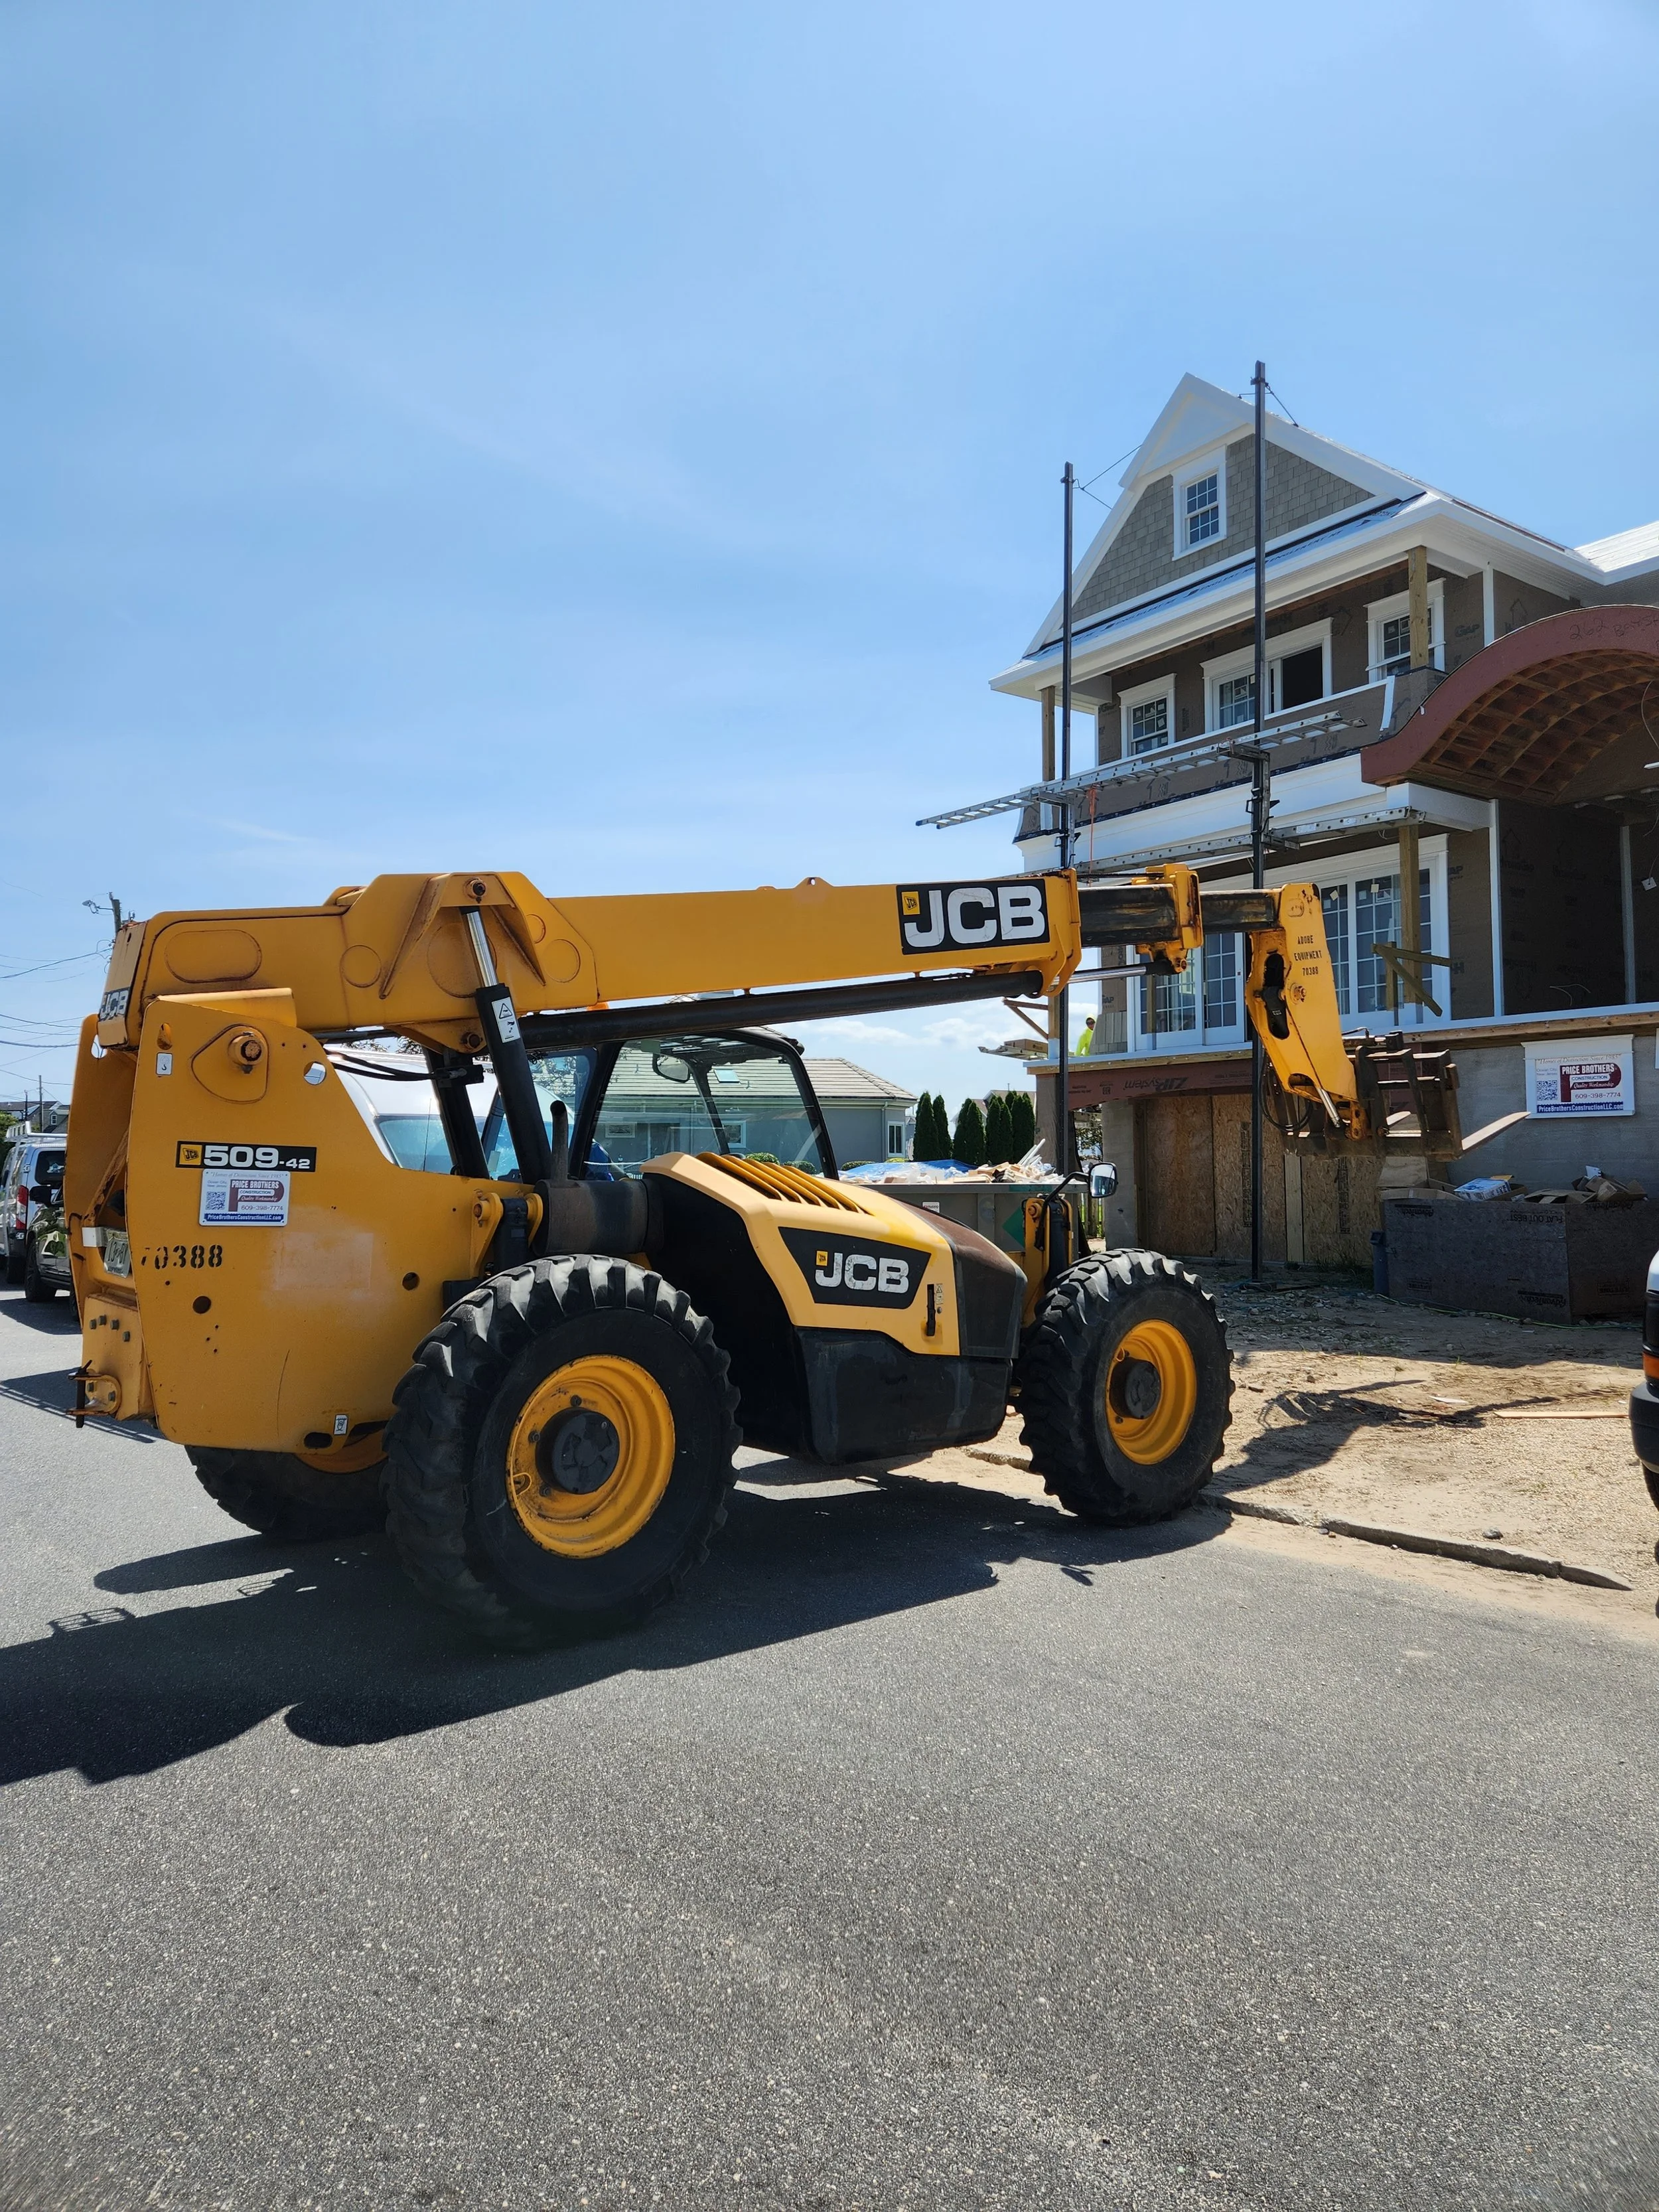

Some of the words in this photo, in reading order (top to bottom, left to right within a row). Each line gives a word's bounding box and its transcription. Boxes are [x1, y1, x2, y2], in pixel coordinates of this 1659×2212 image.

[904, 897, 917, 910] JCB
[904, 885, 1045, 948] JCB
[1297, 934, 1314, 945] ADOBE
[1293, 950, 1323, 962] EQUIPMENT
[1302, 966, 1319, 976] 70388
[100, 990, 129, 1020] JCB
[1562, 1065, 1580, 1074] PRICE
[1582, 1064, 1615, 1074] BROTHERS
[182, 1148, 199, 1161] JCB
[203, 1145, 311, 1169] 509-42
[1529, 1214, 1544, 1223] OUT
[1546, 1215, 1563, 1224] FLAT
[815, 1252, 909, 1293] JCB
